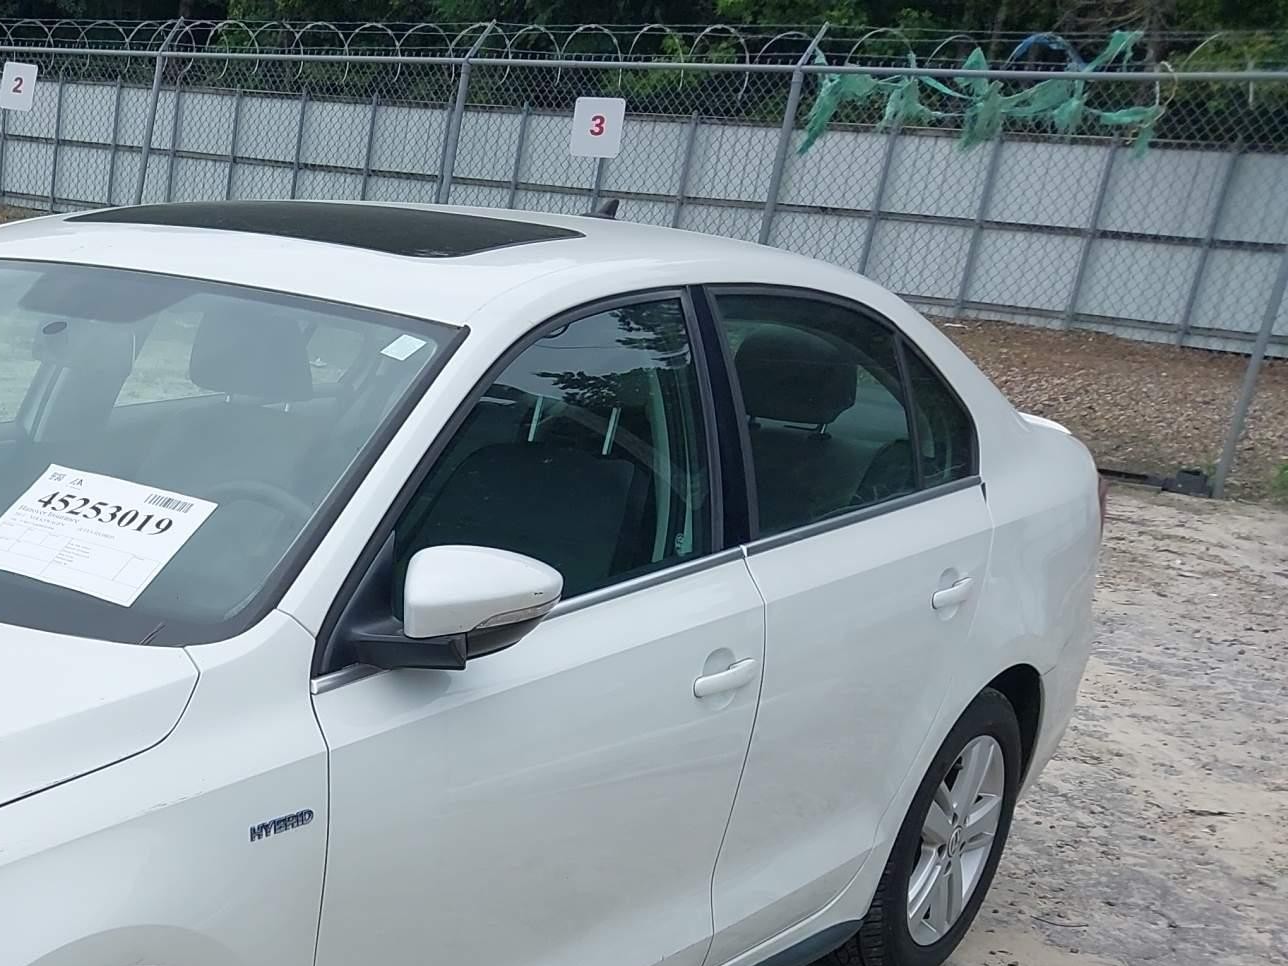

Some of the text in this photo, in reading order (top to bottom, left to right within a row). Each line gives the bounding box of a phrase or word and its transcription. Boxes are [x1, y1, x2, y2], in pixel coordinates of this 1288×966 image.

[12, 76, 24, 93] 2
[589, 115, 605, 136] 3
[38, 490, 173, 536] 45253019
[250, 808, 314, 842] HYBRID
